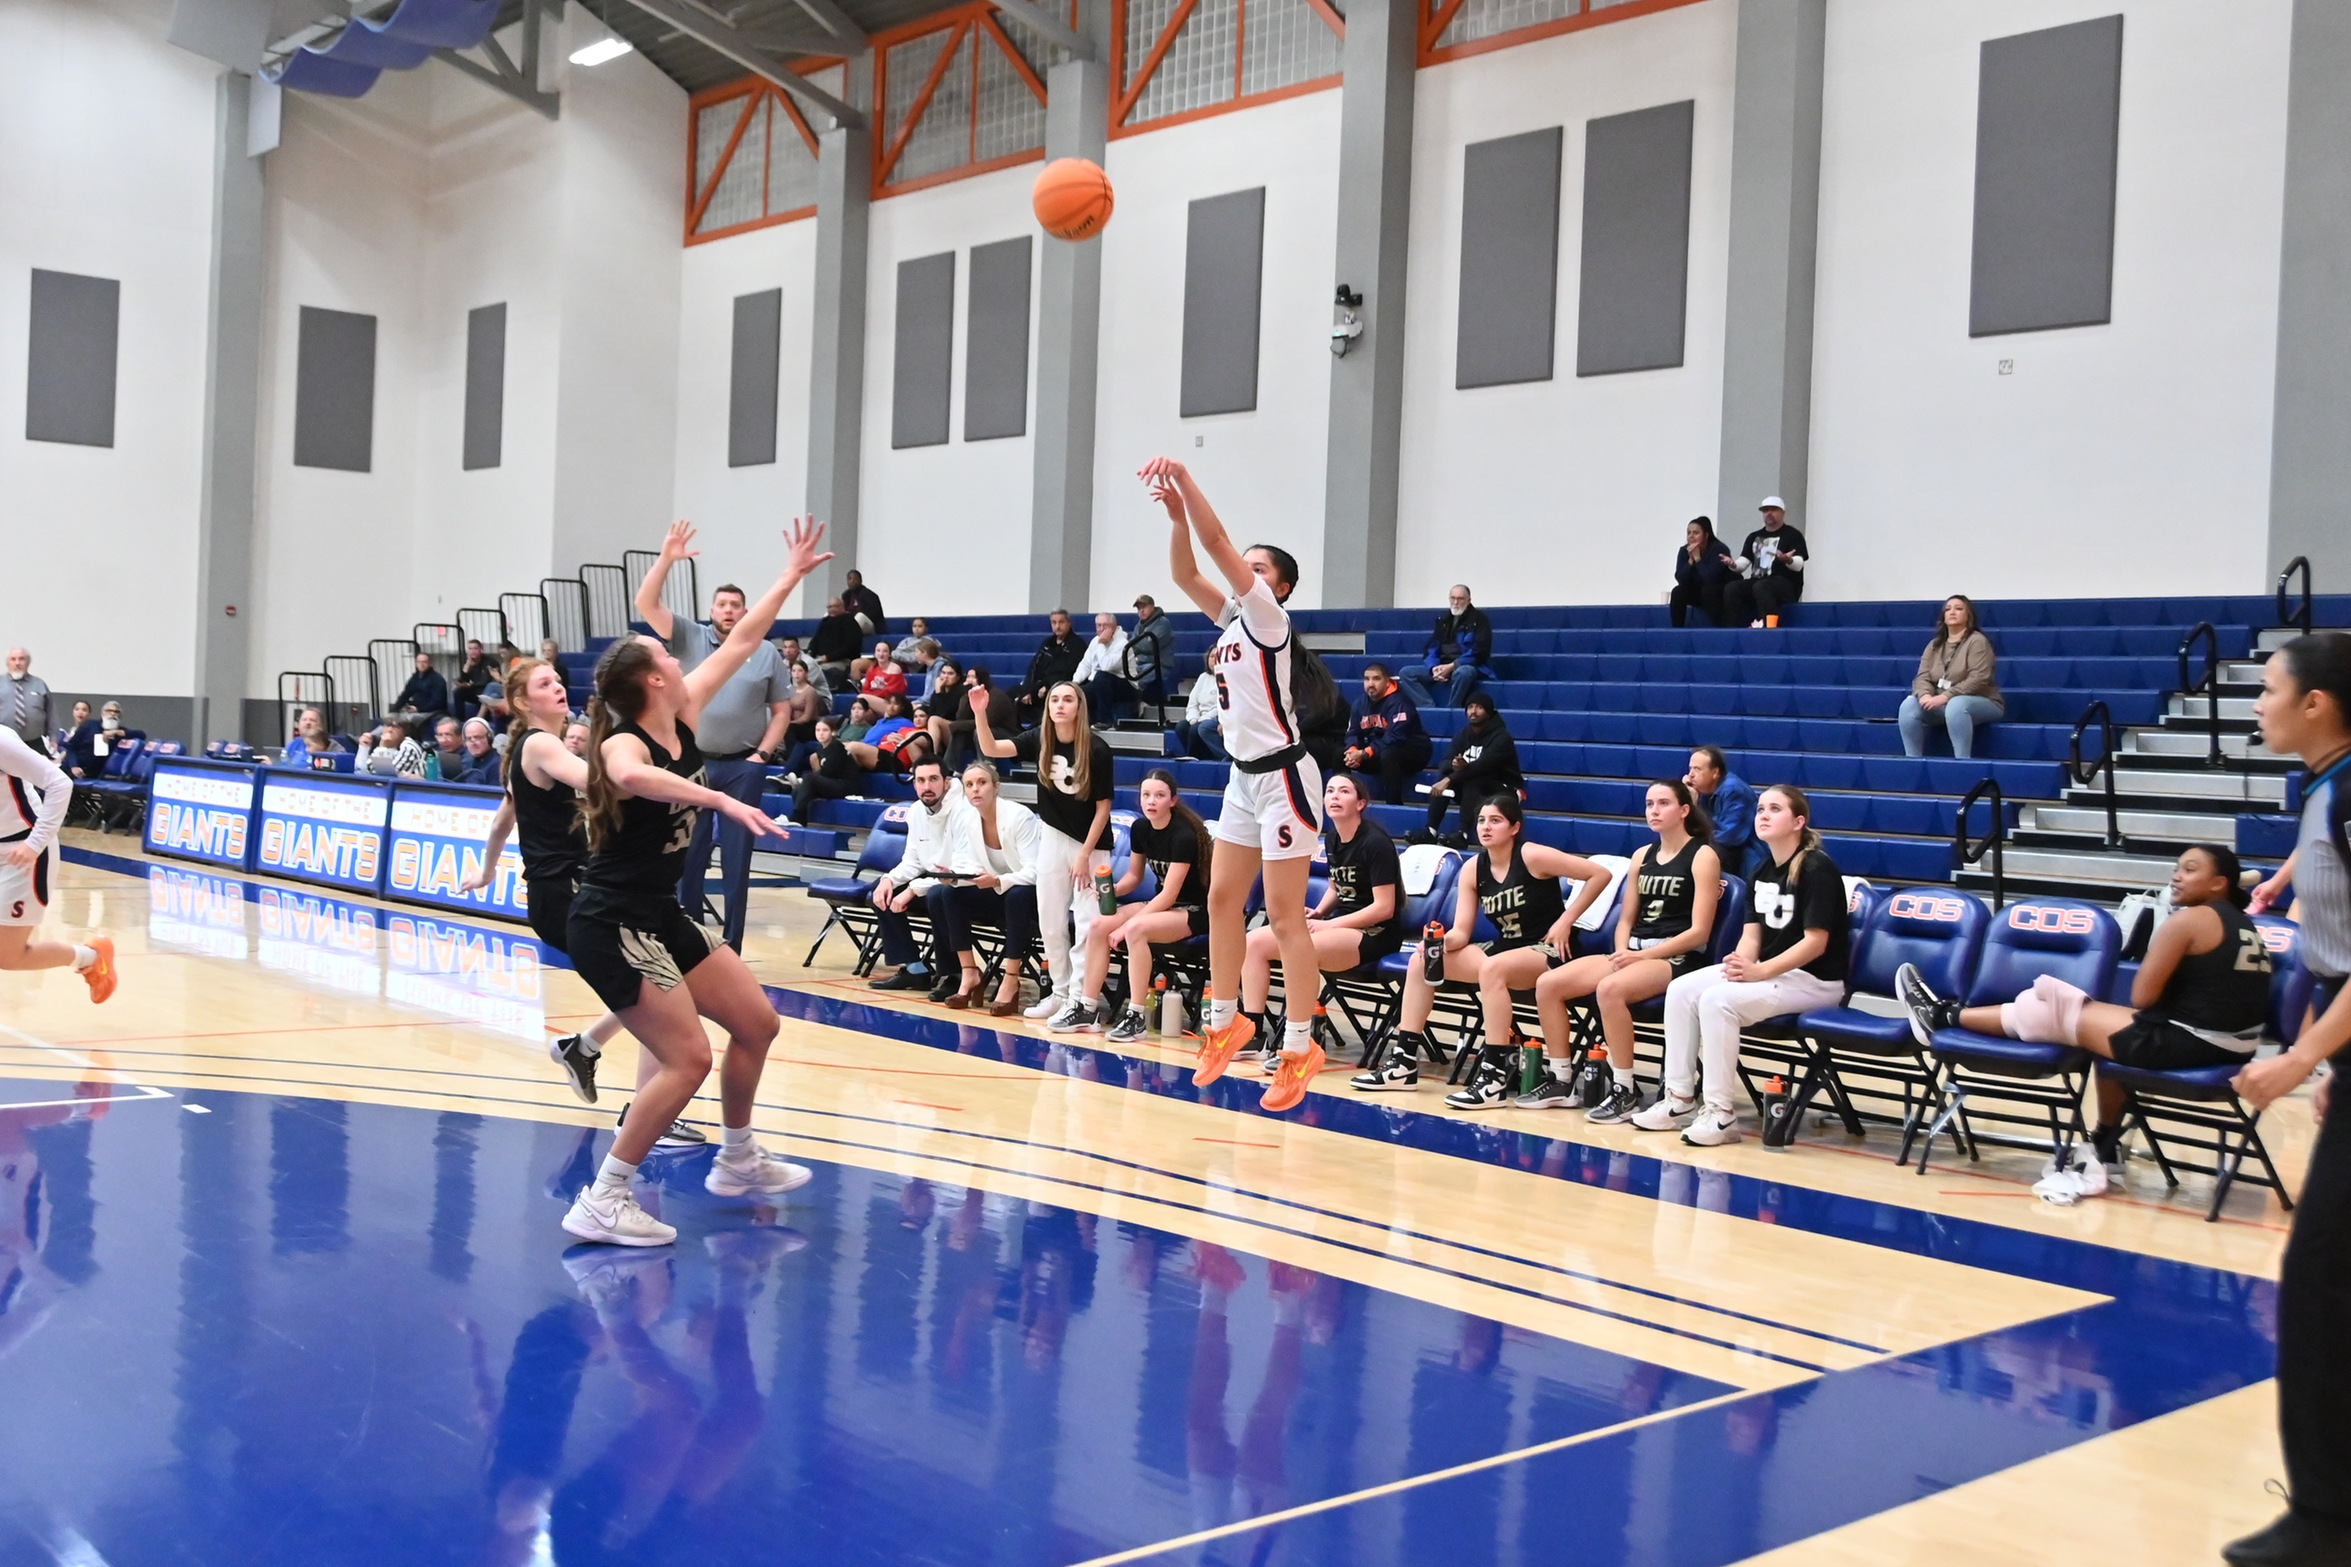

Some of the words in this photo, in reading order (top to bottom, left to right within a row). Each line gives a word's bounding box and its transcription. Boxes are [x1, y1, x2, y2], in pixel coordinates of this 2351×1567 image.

[411, 807, 460, 833] HOME
[467, 813, 491, 835] OF
[884, 806, 909, 822] CO
[151, 803, 248, 859] GIANTS
[1277, 824, 1294, 849] S
[261, 818, 381, 882] GIANTS
[1099, 883, 1110, 894] G
[11, 901, 25, 918] S
[1889, 894, 1965, 922] COS
[2008, 905, 2096, 934] COS
